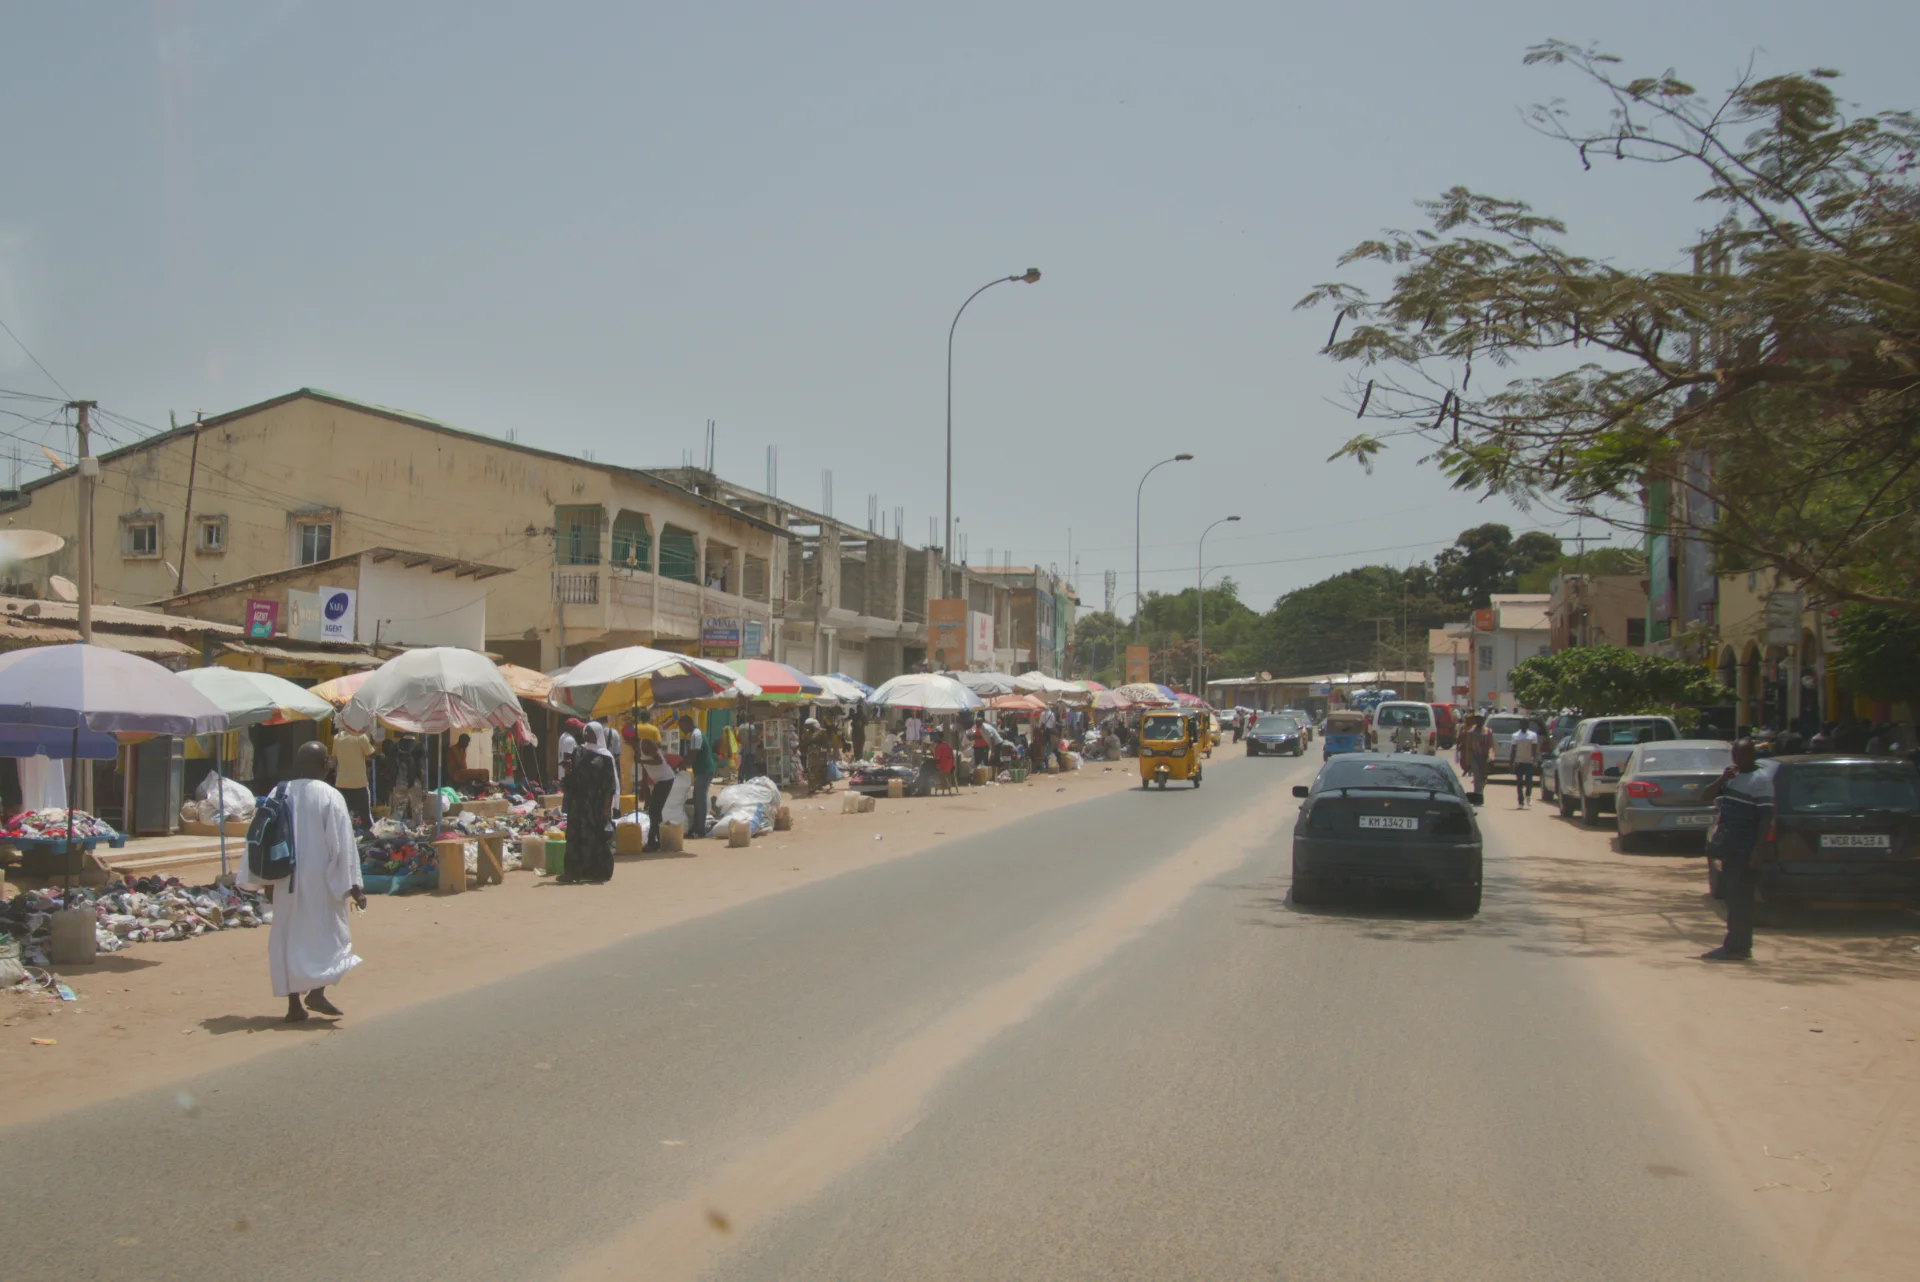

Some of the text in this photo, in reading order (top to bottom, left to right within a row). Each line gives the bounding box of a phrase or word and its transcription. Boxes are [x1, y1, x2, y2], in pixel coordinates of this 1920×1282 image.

[253, 611, 269, 622] AGENT
[324, 624, 343, 633] AGENT
[1368, 817, 1380, 827] KM
[1382, 818, 1404, 828] 1342
